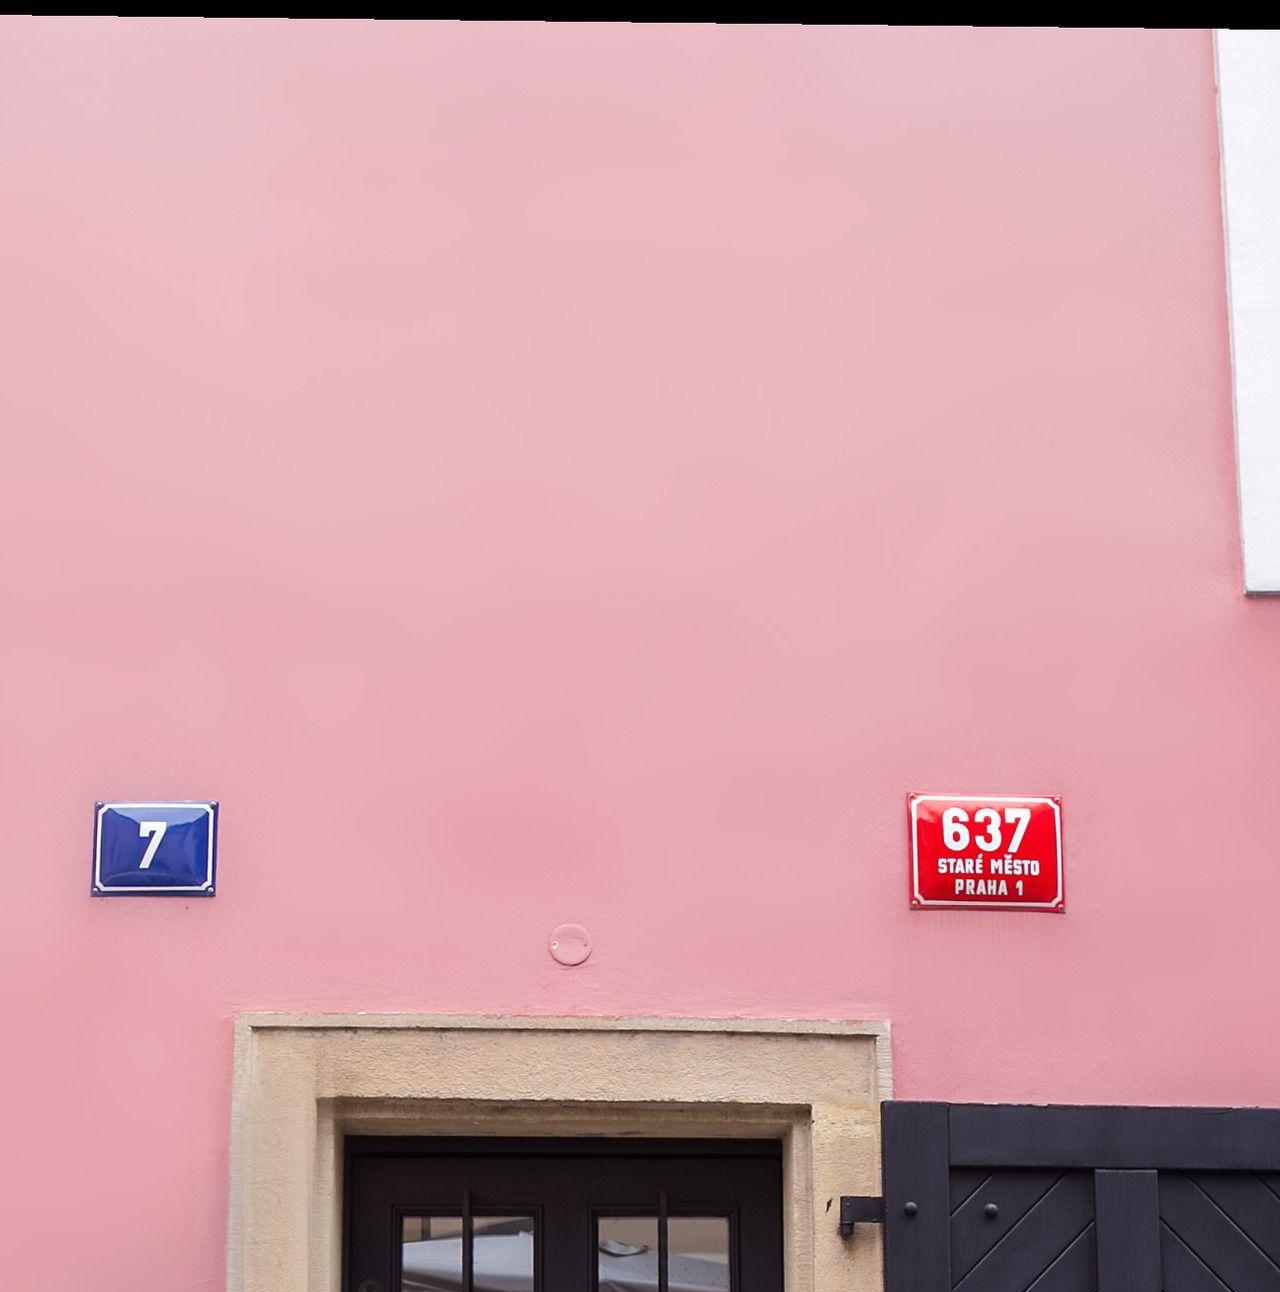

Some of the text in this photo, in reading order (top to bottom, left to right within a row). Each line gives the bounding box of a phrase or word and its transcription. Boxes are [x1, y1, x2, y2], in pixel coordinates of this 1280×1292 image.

[139, 821, 167, 869] 7
[942, 807, 1031, 853] 637
[937, 854, 1040, 876] STARÉ MĚSTO
[954, 879, 1024, 896] PRAHA 1
